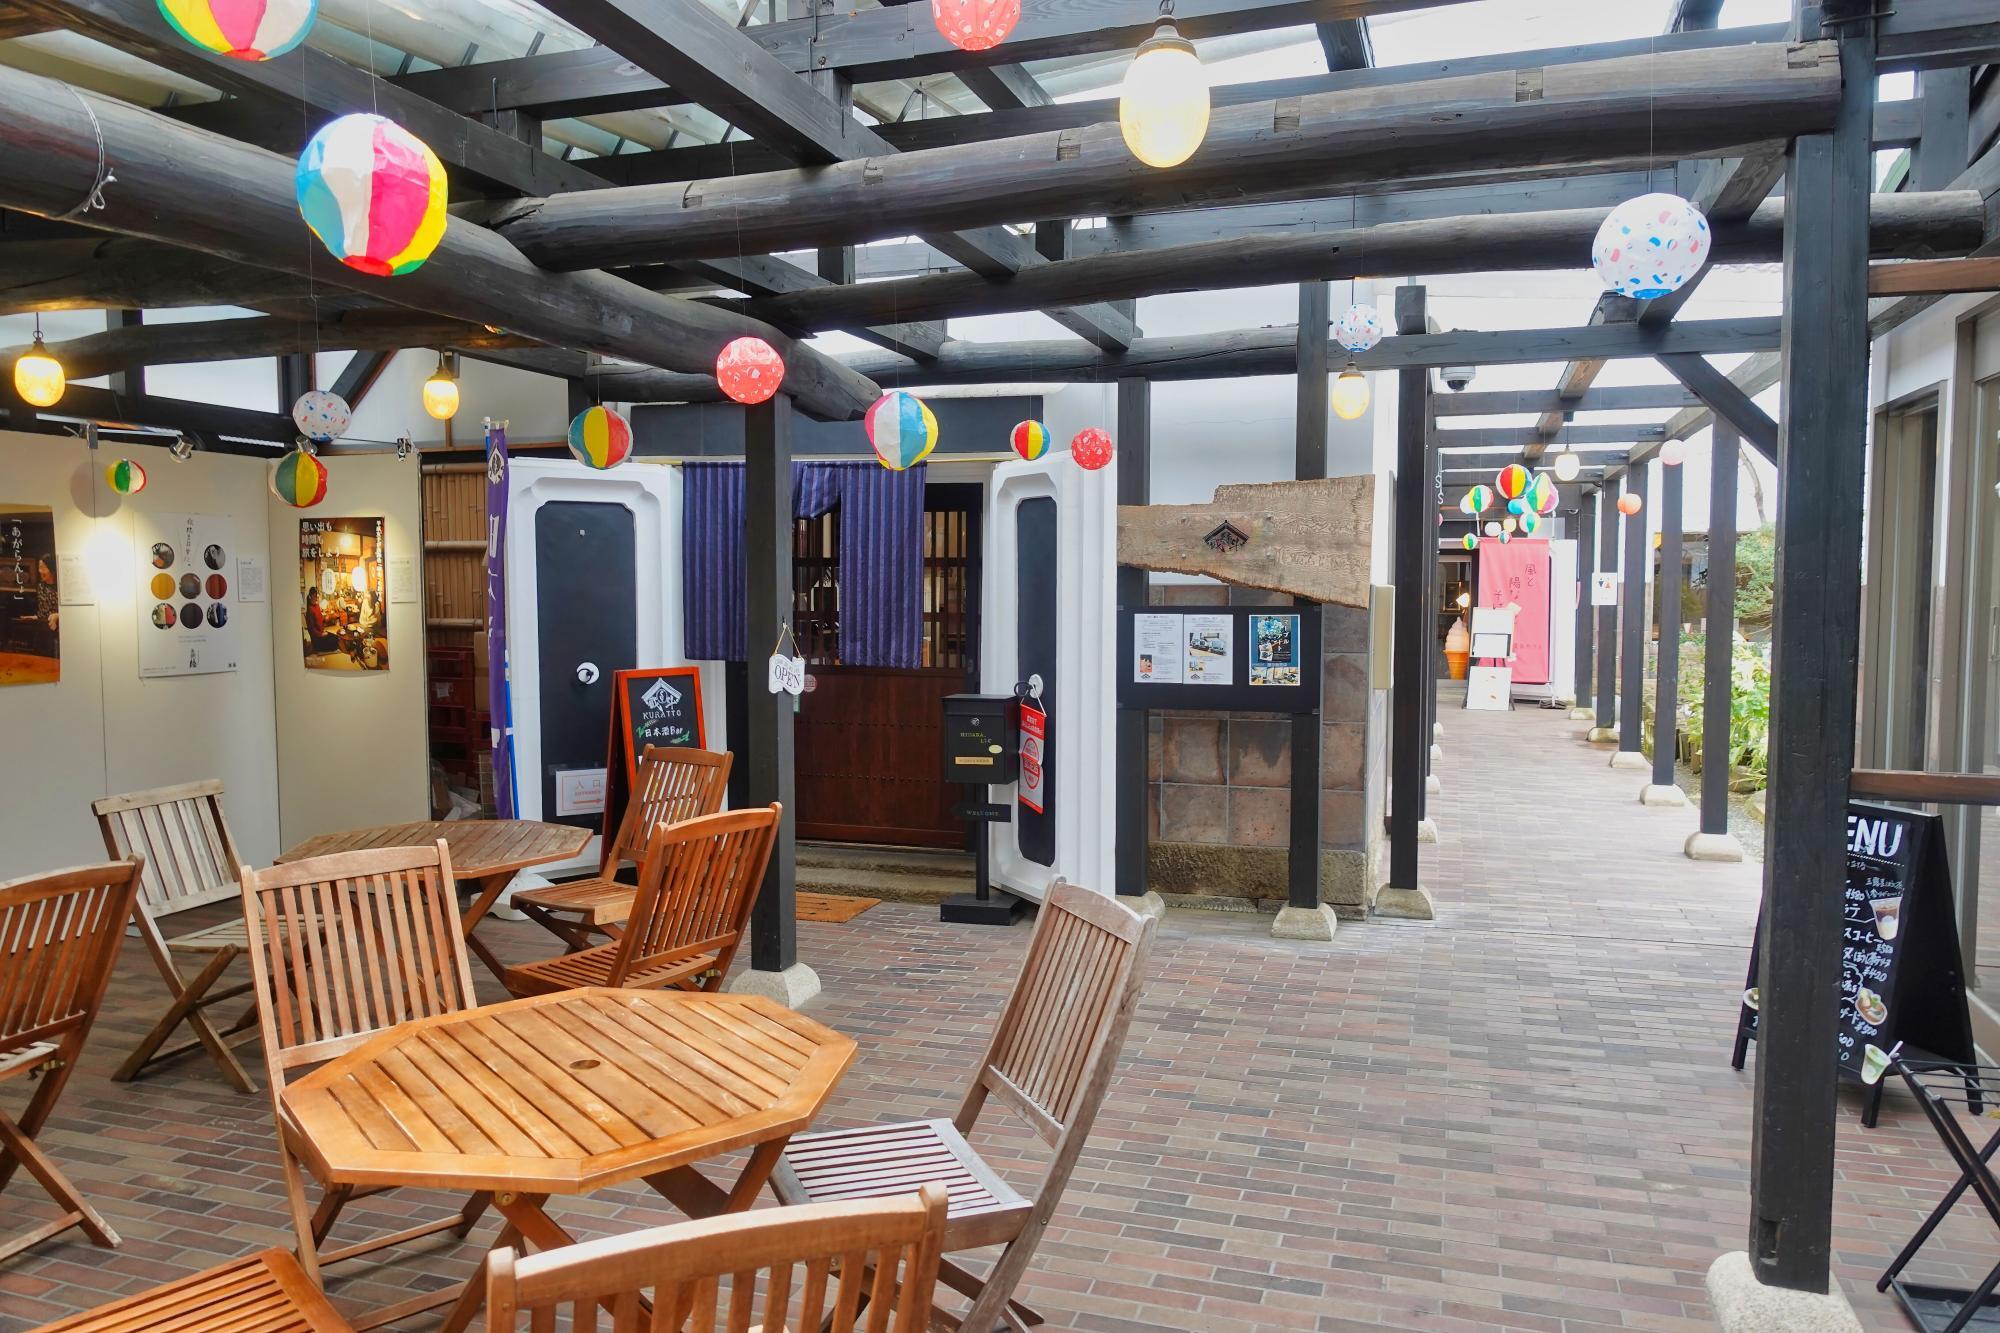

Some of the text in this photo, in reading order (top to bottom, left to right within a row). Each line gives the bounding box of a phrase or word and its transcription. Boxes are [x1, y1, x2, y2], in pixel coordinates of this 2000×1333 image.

[302, 521, 332, 532] 思い出も
[774, 664, 801, 689] OPEN
[642, 709, 682, 720] KURATTO
[644, 725, 684, 738] 日本酒Bar
[575, 777, 601, 788] 入口
[1847, 816, 1903, 857] ENU
